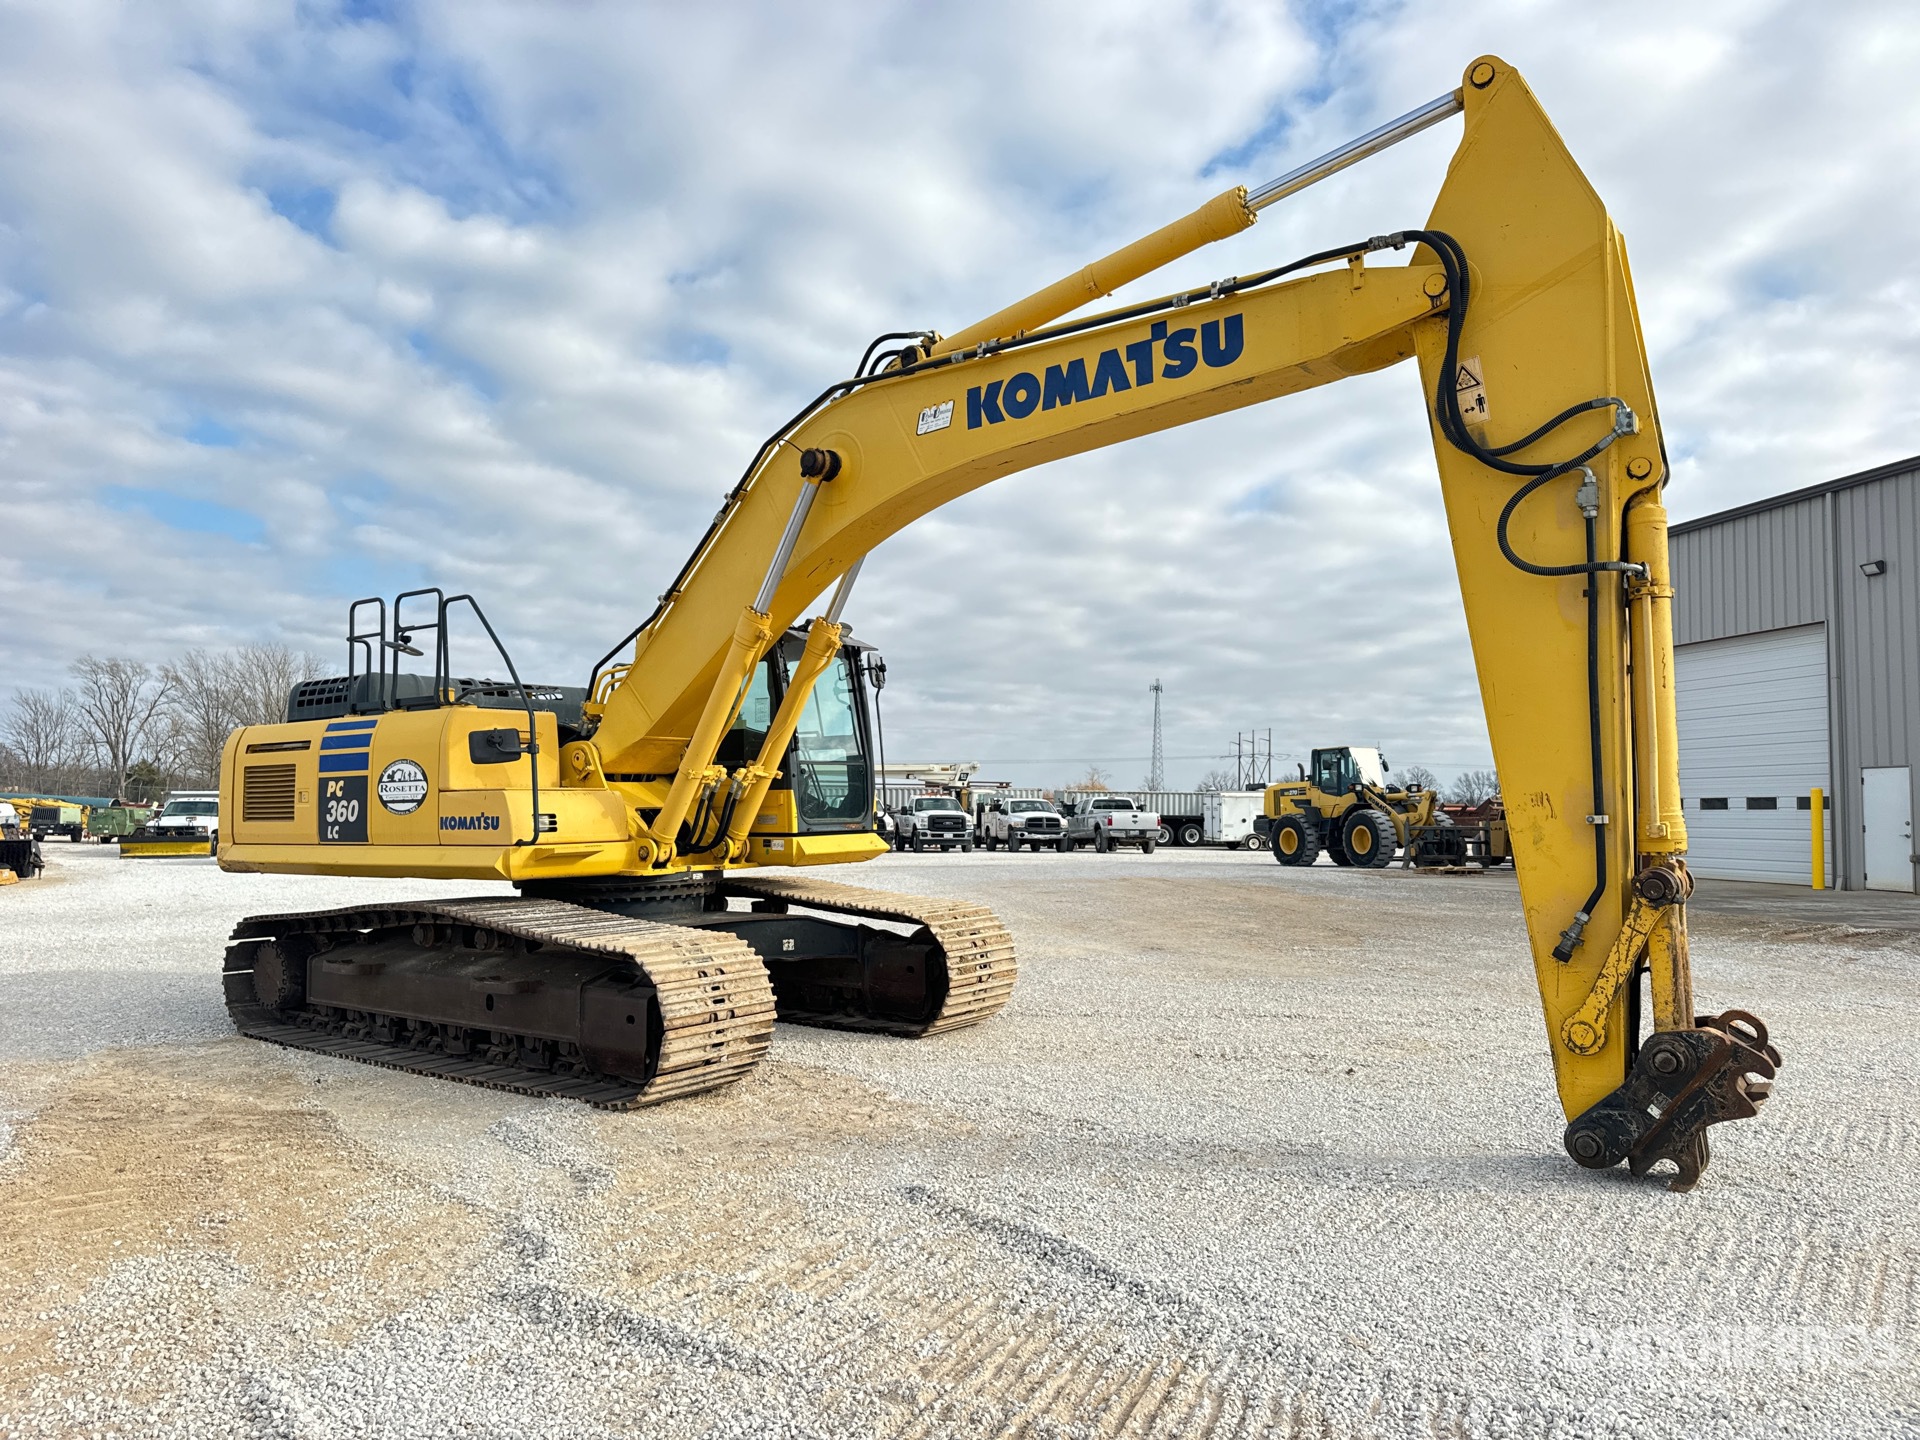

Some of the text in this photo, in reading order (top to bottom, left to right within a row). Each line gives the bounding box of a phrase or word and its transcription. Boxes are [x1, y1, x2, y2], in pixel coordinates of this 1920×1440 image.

[966, 312, 1245, 430] KOMATSU
[326, 780, 345, 798] PC
[380, 783, 426, 793] ROSETTA
[326, 799, 359, 823] 360
[1368, 795, 1392, 816] KOMATSU
[439, 811, 500, 831] KOMATSU
[327, 825, 340, 839] LC
